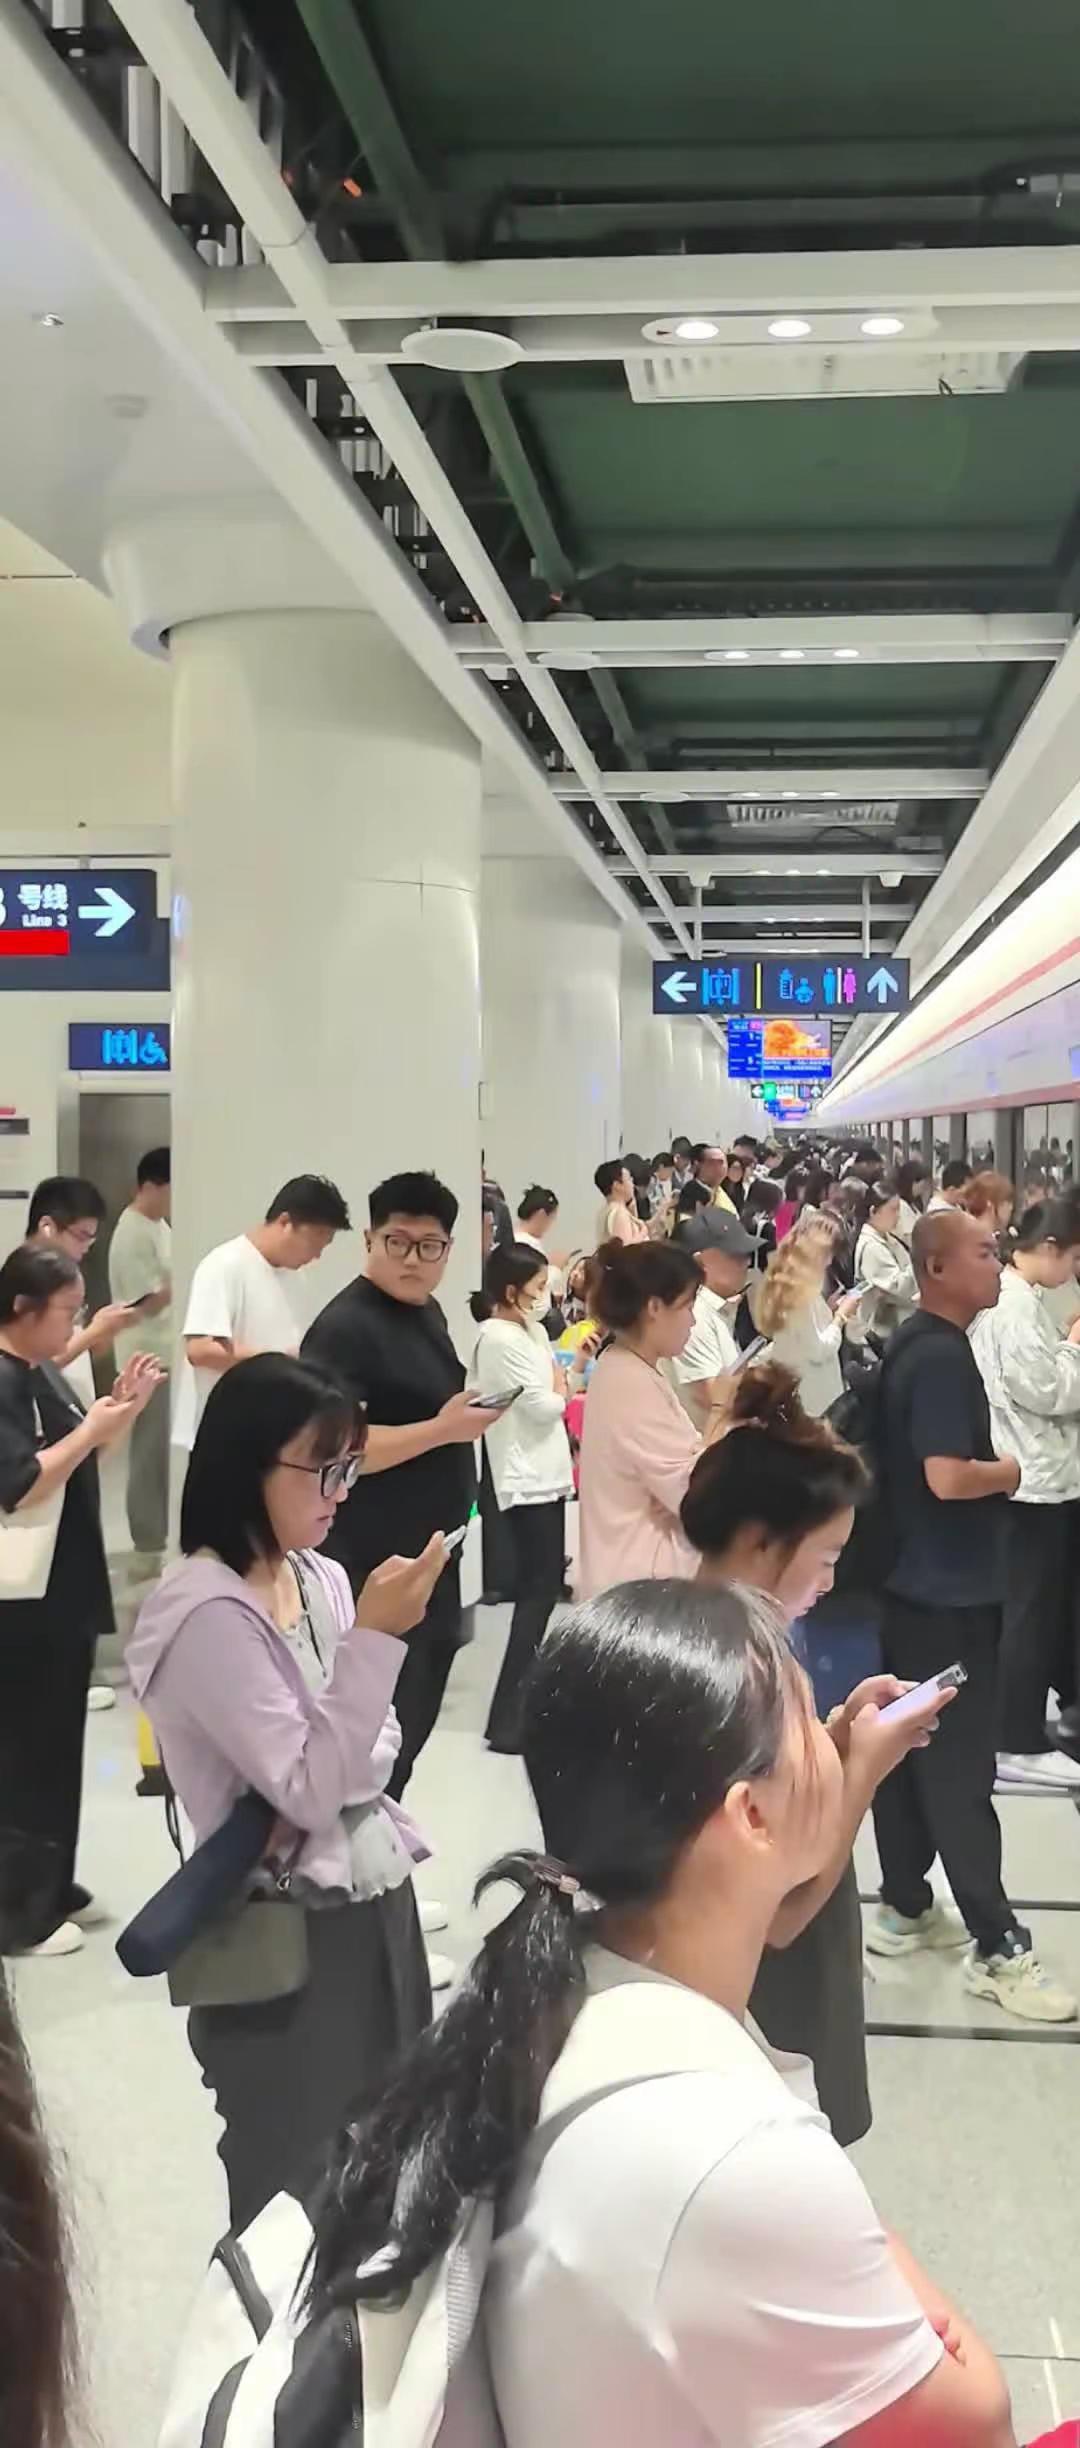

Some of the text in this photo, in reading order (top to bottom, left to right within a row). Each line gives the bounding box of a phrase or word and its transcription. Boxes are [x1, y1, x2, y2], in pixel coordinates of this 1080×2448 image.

[17, 883, 69, 911] 号线
[22, 913, 68, 928] Line 3
